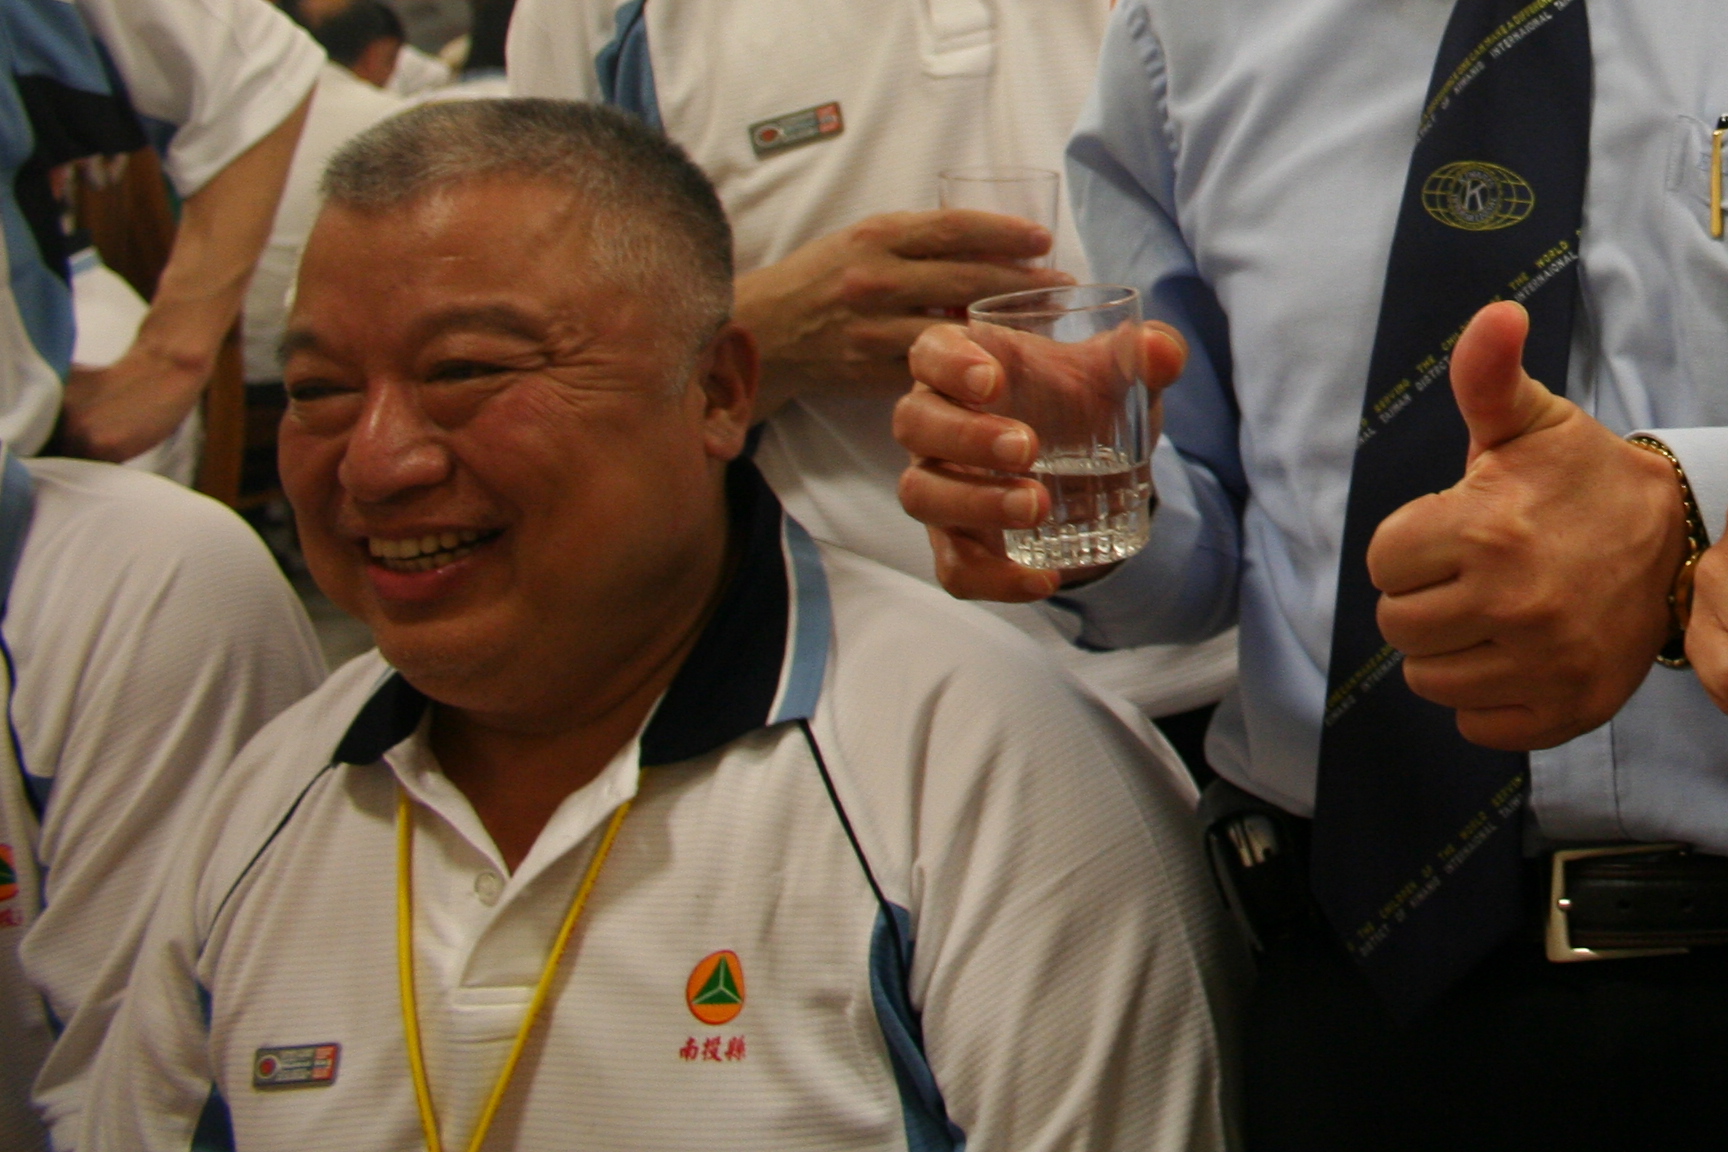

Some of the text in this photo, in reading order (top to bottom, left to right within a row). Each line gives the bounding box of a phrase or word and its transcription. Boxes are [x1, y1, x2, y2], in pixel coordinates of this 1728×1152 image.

[1462, 179, 1487, 212] K
[1373, 378, 1411, 413] SERVING
[1415, 354, 1437, 373] THE
[1508, 272, 1531, 290] THE
[1535, 240, 1570, 269] WORLD
[1437, 843, 1457, 860] THE
